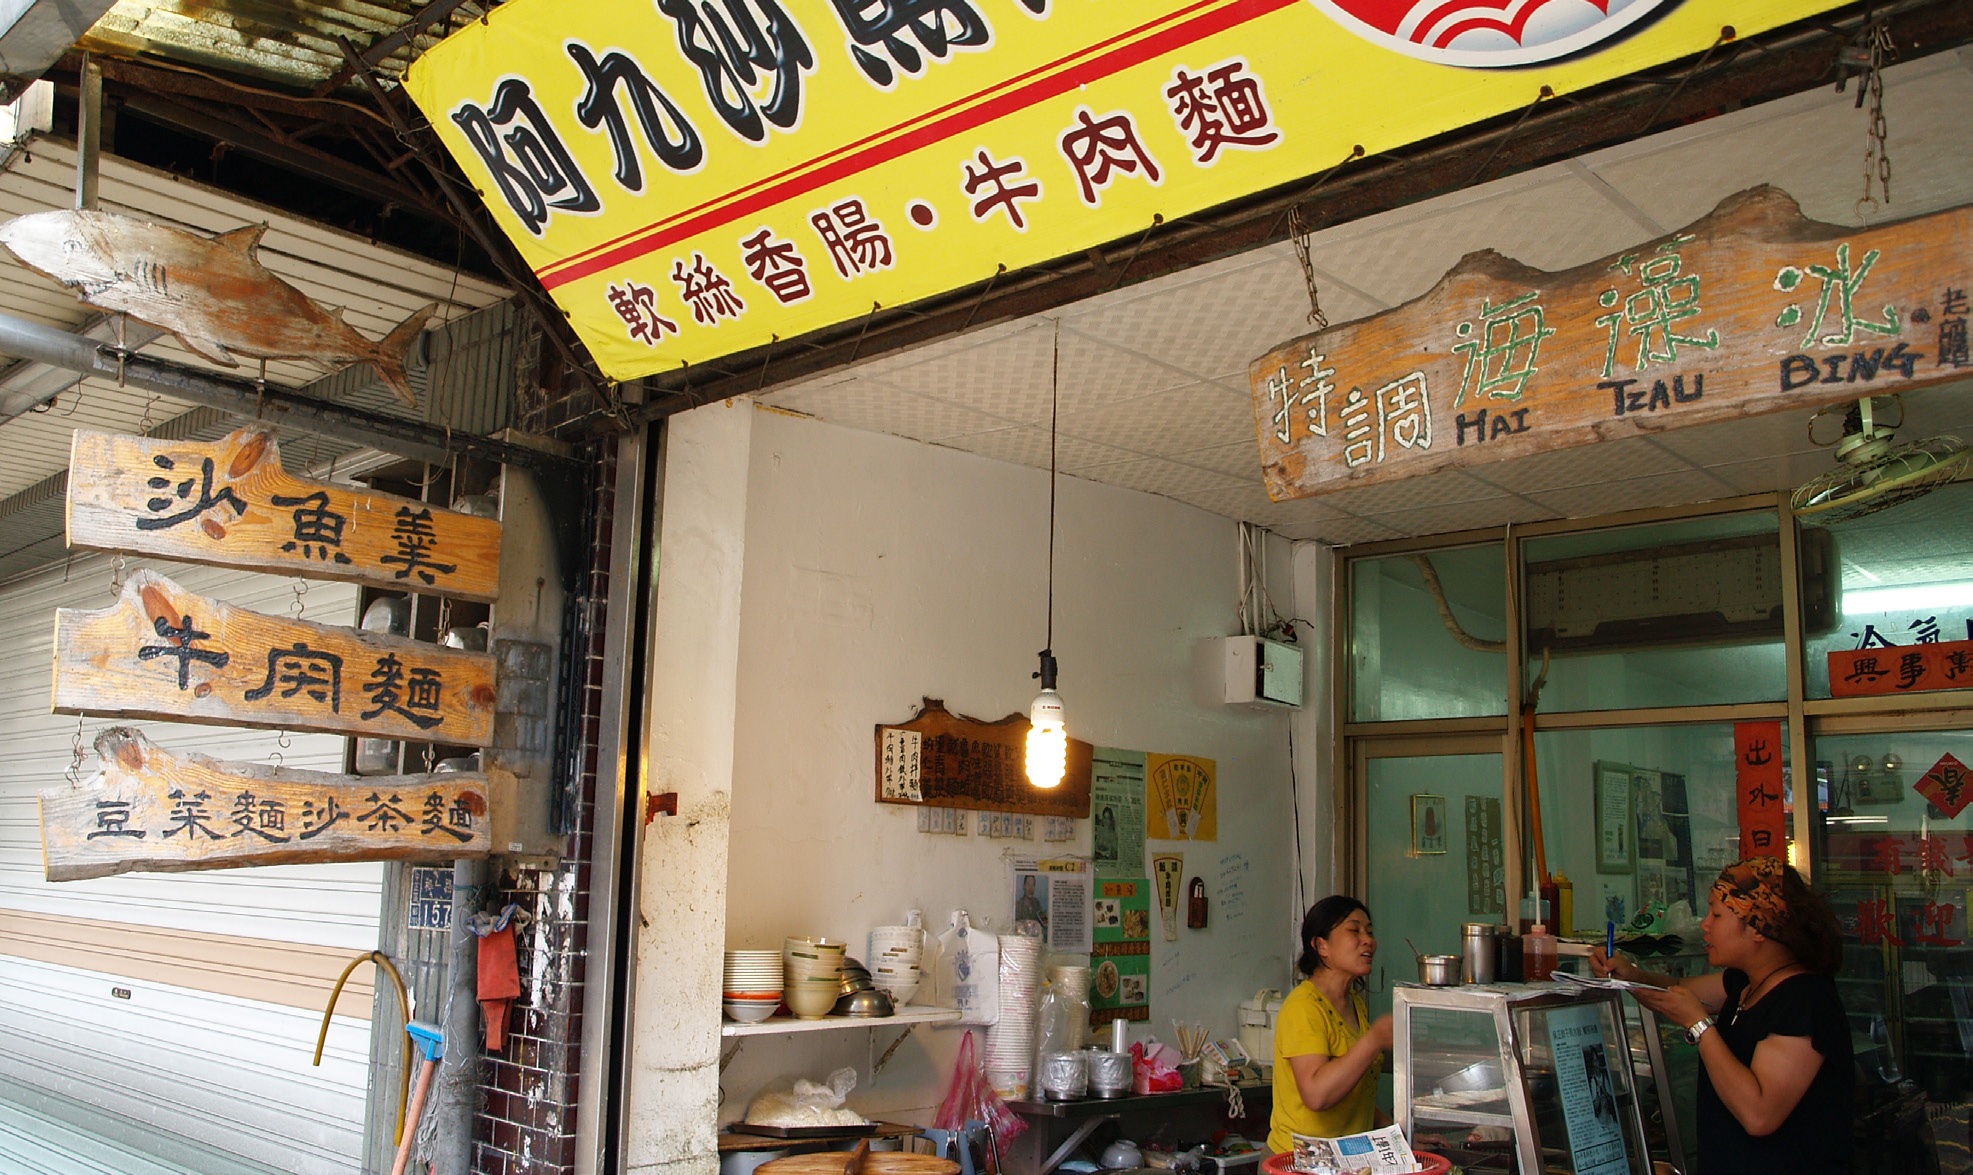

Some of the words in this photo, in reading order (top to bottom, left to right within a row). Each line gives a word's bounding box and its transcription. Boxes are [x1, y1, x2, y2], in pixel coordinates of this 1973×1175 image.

[1455, 408, 1531, 446] HAI
[1597, 374, 1704, 416] TZAU
[1779, 343, 1924, 392] BING
[138, 614, 445, 729] 牛肉麵
[1927, 766, 1968, 807] 春
